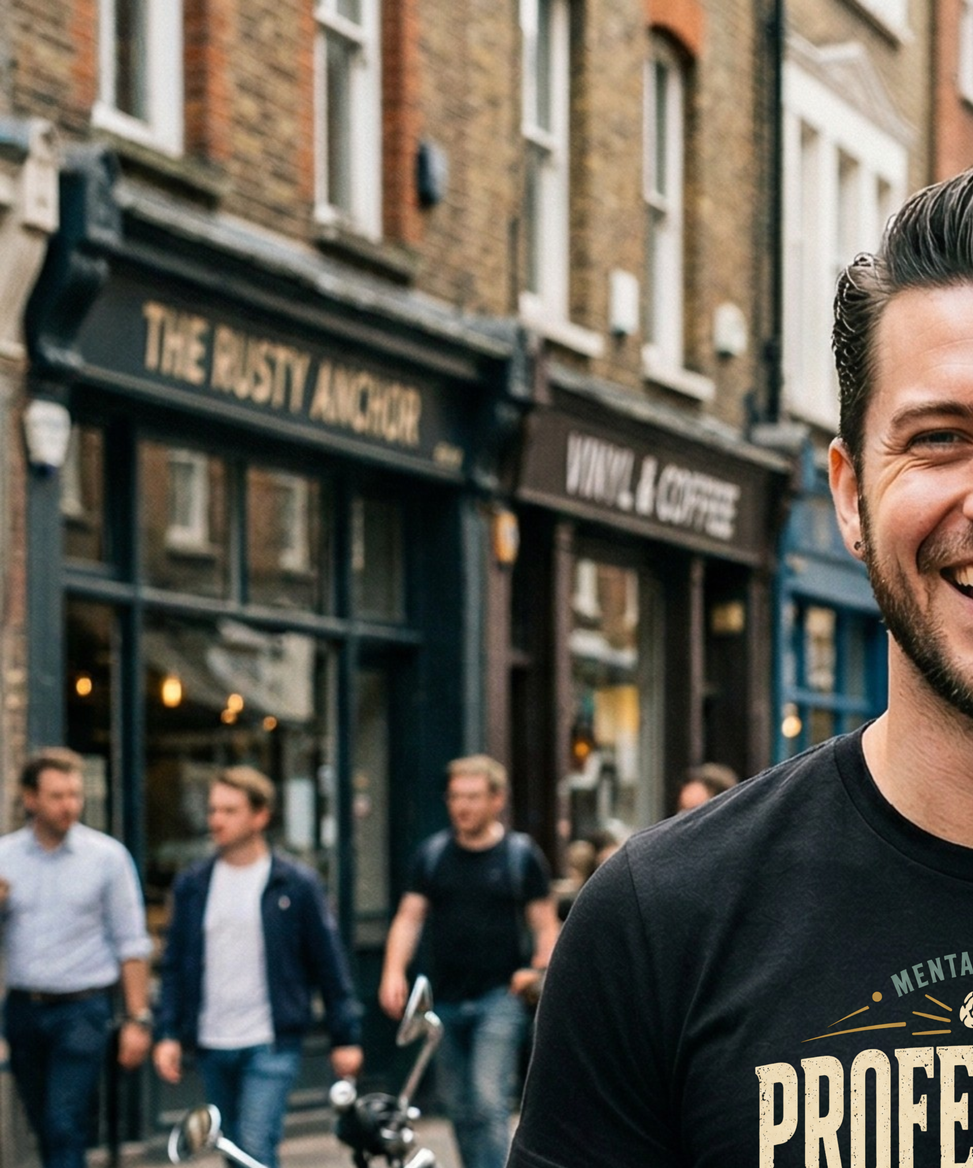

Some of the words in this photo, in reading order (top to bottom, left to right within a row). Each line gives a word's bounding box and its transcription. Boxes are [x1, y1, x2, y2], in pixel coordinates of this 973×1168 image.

[143, 301, 209, 387] THE
[209, 323, 311, 415] RUSTY
[308, 359, 422, 447] ANCHOR
[566, 429, 635, 512] VINYL
[635, 455, 658, 516] &
[656, 463, 741, 540] COFFEE
